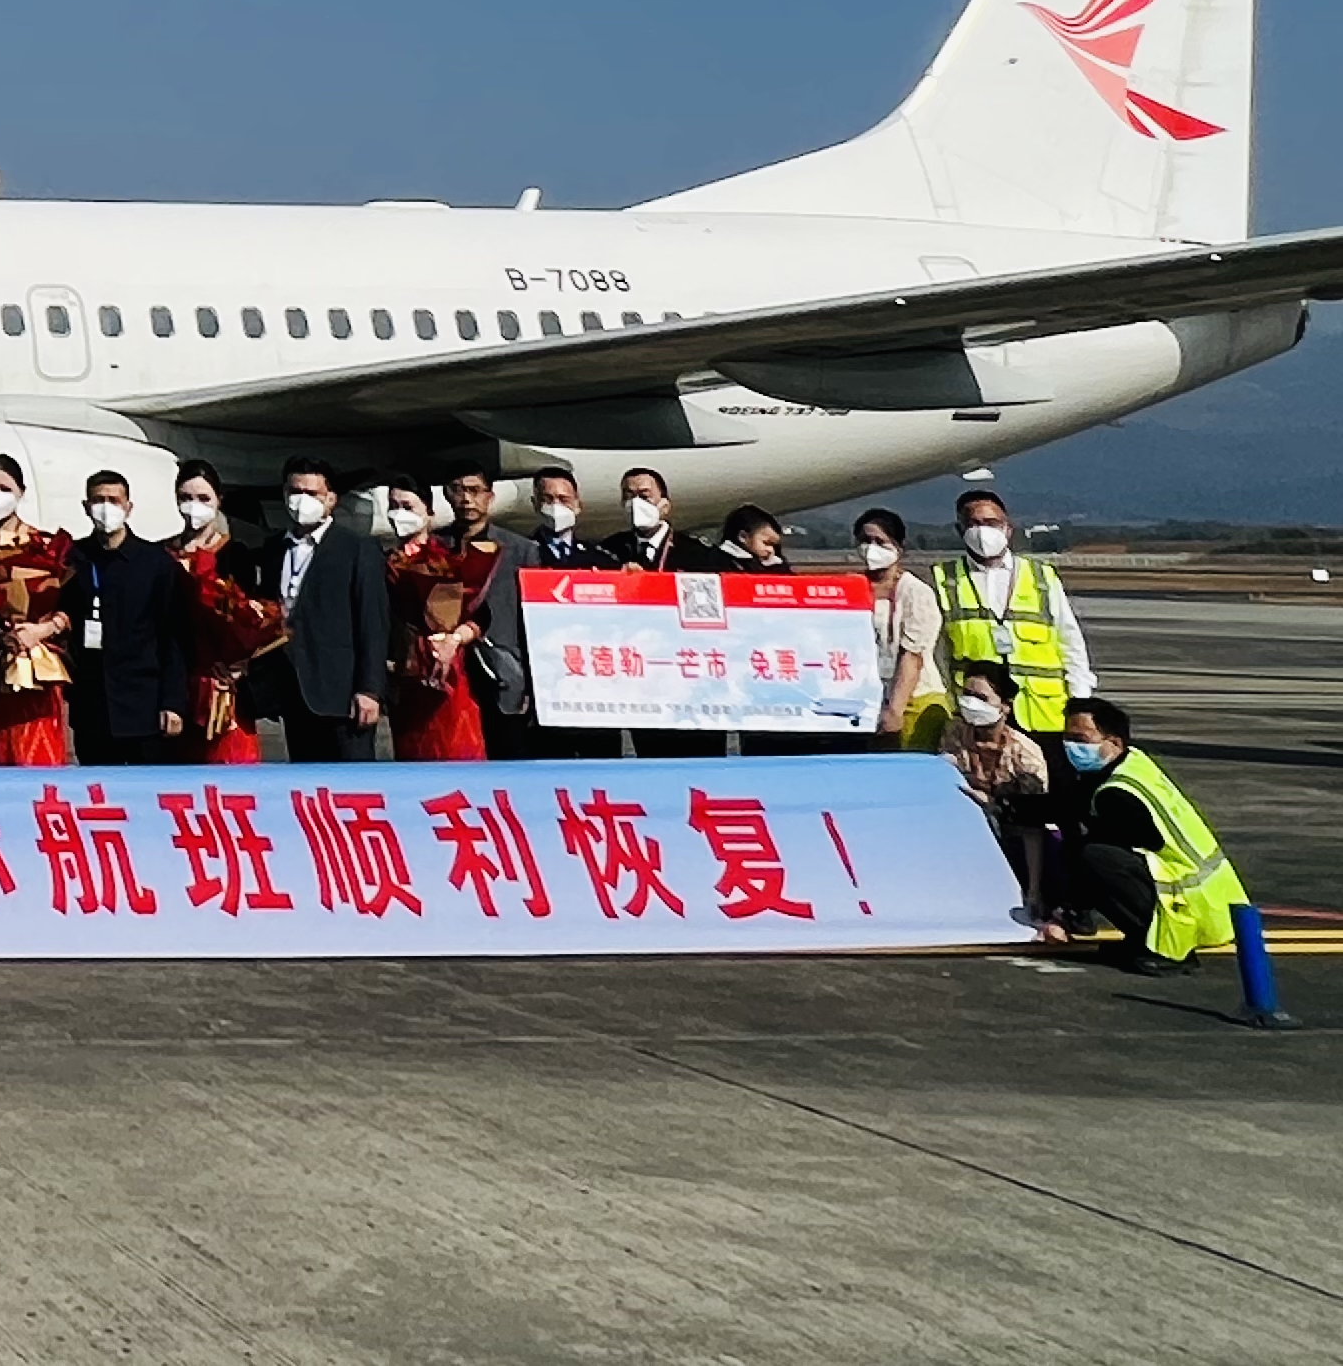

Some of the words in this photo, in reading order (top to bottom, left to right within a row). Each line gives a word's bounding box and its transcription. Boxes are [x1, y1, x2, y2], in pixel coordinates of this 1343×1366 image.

[505, 268, 631, 292] B-7088
[750, 649, 853, 682] 免票一张
